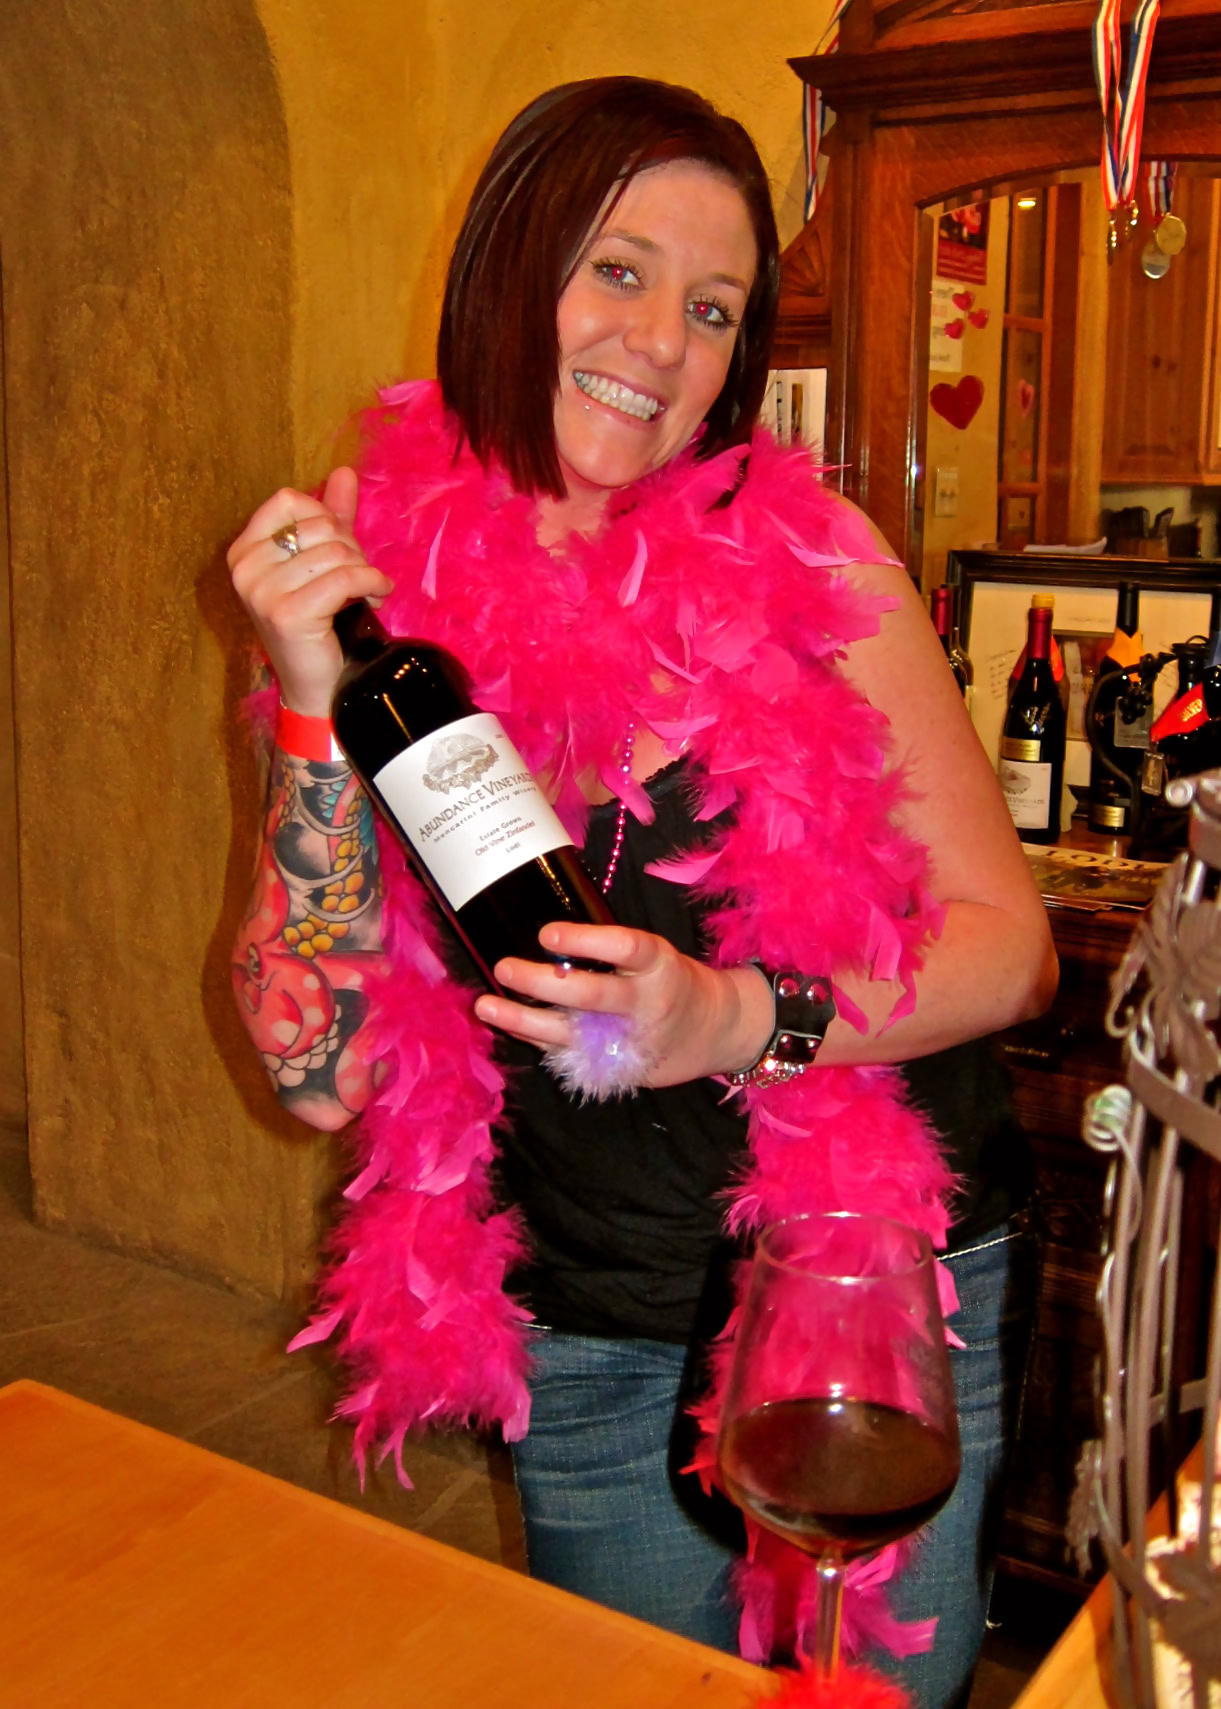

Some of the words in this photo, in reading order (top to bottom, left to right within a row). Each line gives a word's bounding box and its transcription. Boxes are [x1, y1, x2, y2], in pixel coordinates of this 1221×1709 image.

[1182, 698, 1203, 722] SILVER
[480, 794, 510, 812] Family
[419, 789, 486, 842] ABUNDANCE
[474, 844, 489, 857] Old
[488, 835, 505, 847] Vine
[505, 820, 536, 838] Zinfandel
[479, 827, 500, 841] Estate
[501, 816, 522, 829] Grown
[505, 842, 521, 853] Lodi
